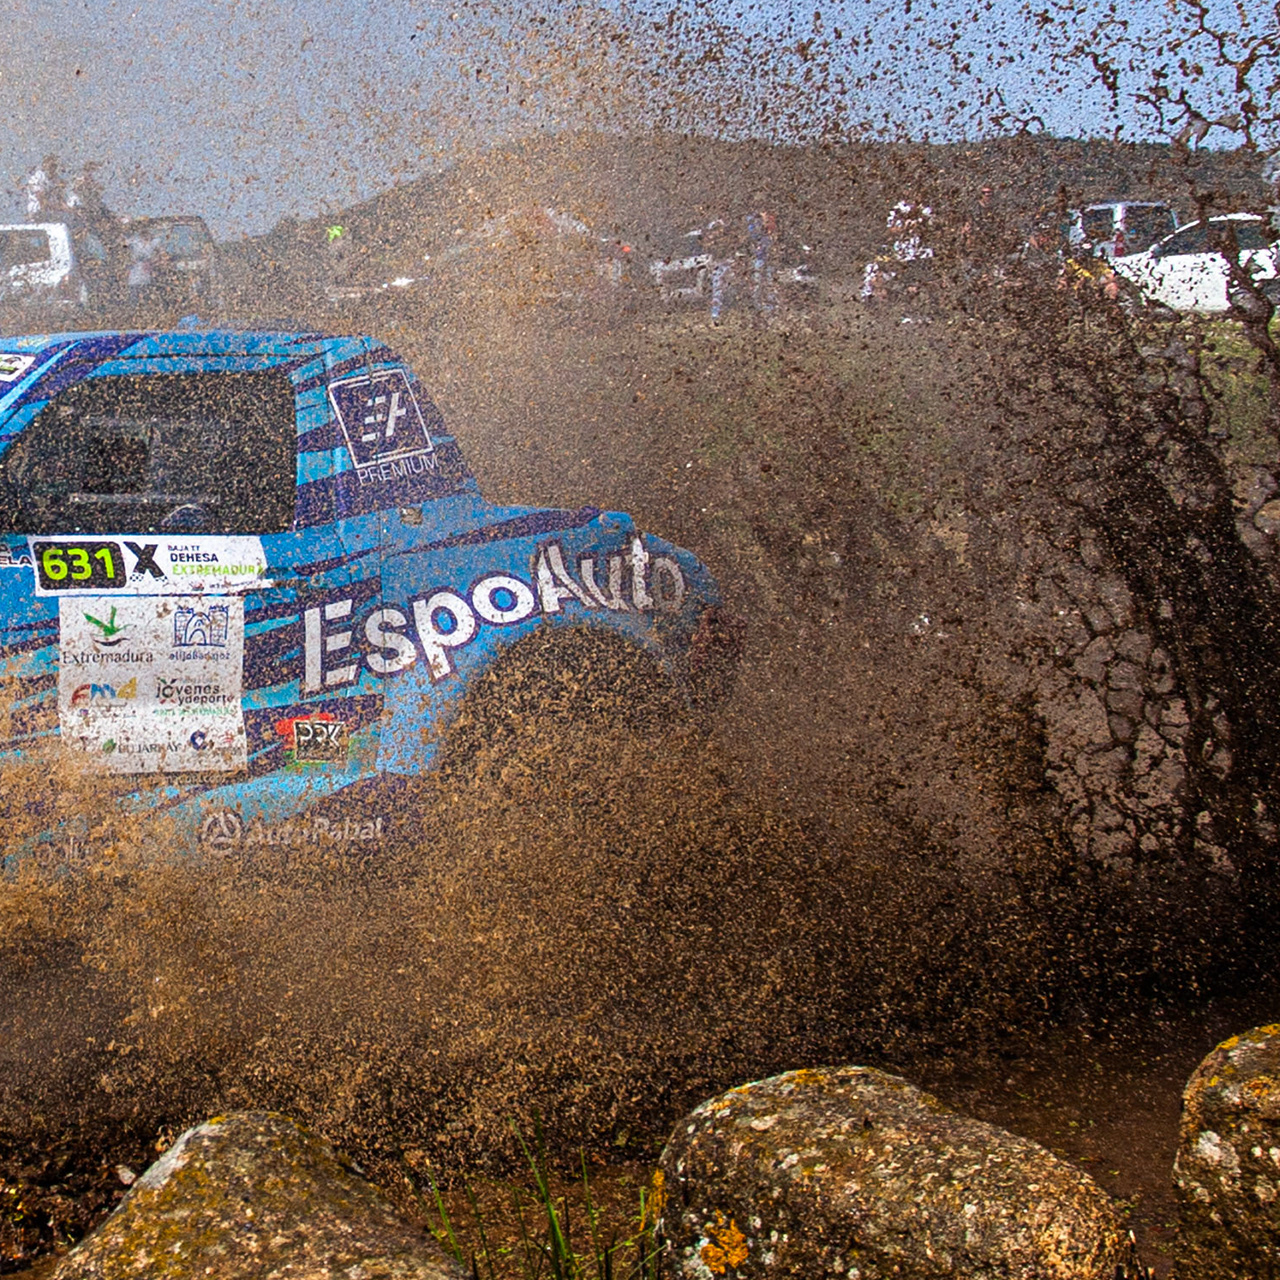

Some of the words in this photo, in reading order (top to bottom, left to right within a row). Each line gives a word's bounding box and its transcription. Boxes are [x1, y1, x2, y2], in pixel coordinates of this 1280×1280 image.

[357, 453, 439, 485] PREMIUM
[42, 547, 116, 581] 631
[170, 553, 219, 563] DEHESA
[172, 564, 265, 576] EXTREMADURA
[302, 536, 685, 694] EspoAuto
[62, 650, 154, 665] Extremadura
